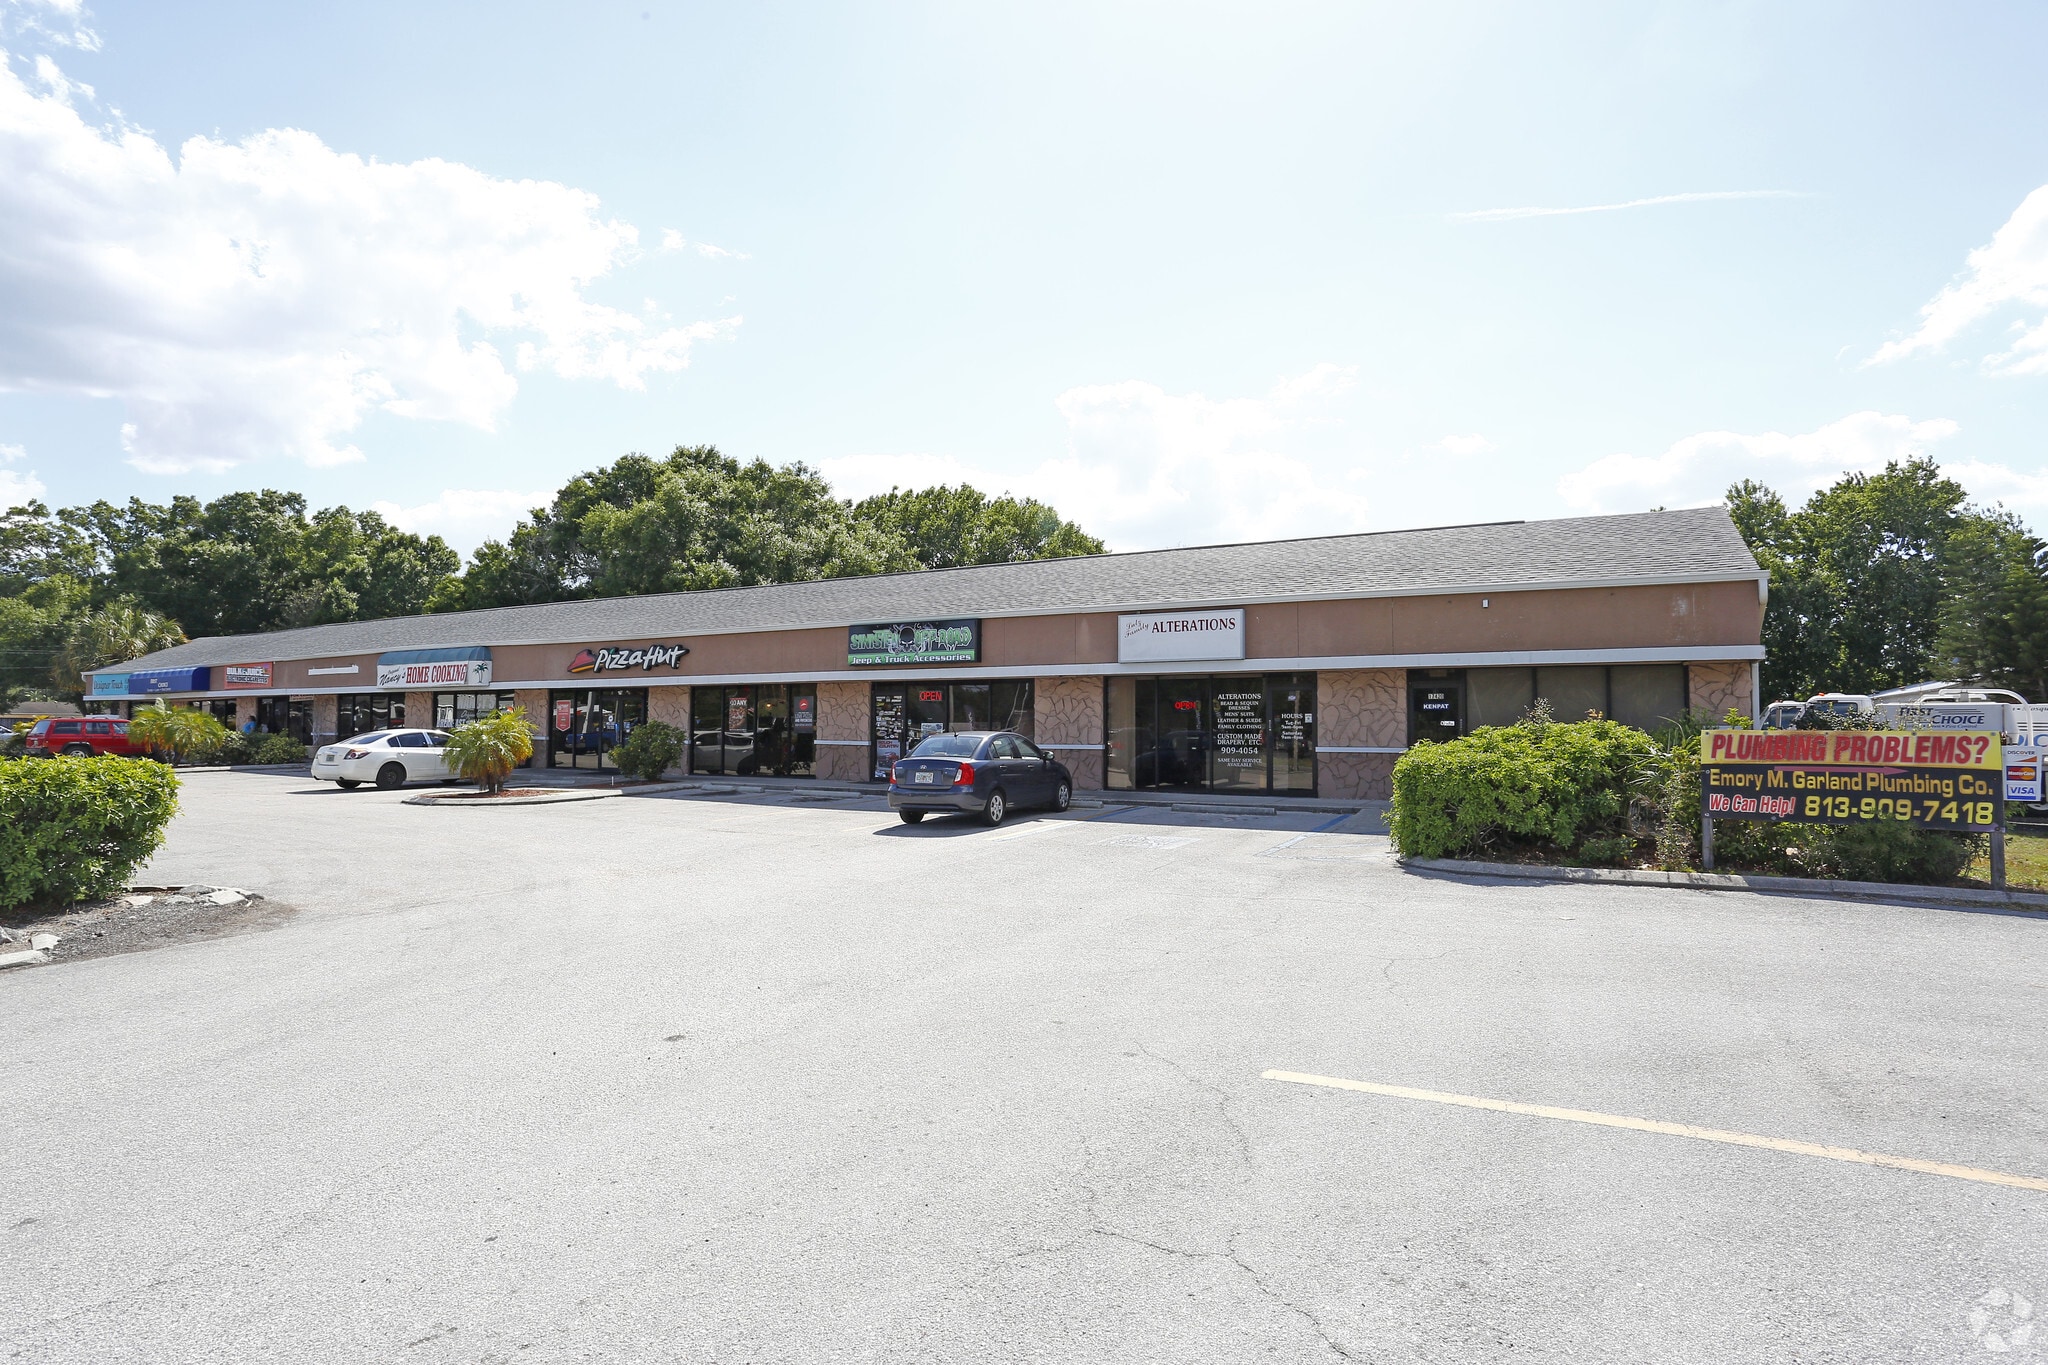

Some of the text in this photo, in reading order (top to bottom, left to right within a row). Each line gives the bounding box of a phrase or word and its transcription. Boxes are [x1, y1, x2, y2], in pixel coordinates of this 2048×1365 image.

[1152, 618, 1236, 633] ALTERATIONS
[593, 645, 687, 672] Pizza Hut
[852, 656, 873, 665] Jeep
[885, 655, 910, 664] Truck
[913, 653, 971, 663] Accessories
[379, 664, 468, 686] Nancy's HOME COOKING
[919, 691, 942, 701] OPEN
[1174, 701, 1197, 709] OPEN
[1900, 707, 1985, 724] FIRST CHOICE
[1220, 746, 1258, 754] 909-4054
[1711, 733, 1990, 764] PLUMBING PROBLEMS?
[1709, 768, 1994, 798] Emory M. Garland Plumbing Co.
[2010, 786, 2035, 794] VISA
[1709, 794, 1797, 818] We Can Help!
[1804, 795, 1994, 825] 813-909-7418
